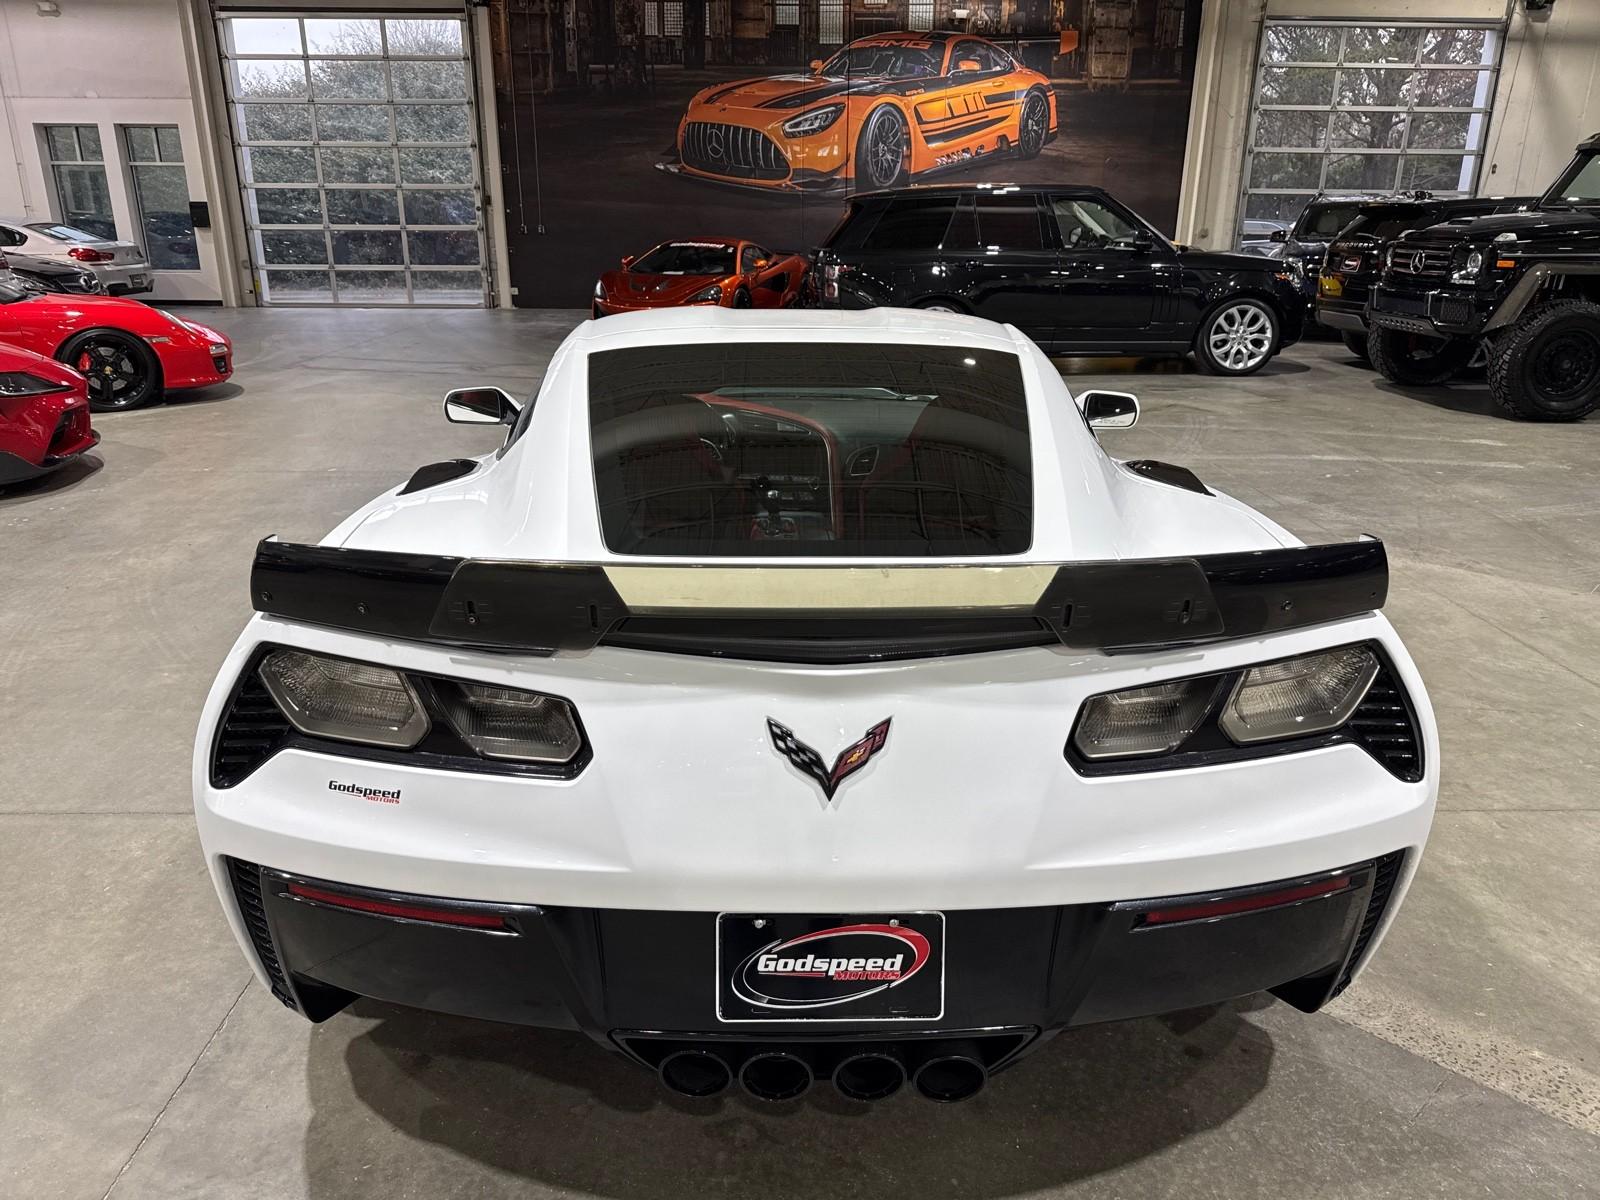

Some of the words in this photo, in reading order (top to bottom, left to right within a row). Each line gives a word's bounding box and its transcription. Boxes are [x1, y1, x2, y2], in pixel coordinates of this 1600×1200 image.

[868, 40, 933, 50] AMG
[328, 780, 401, 799] Godspeed
[366, 795, 400, 804] MOTORS
[757, 954, 904, 976] Godspeed
[833, 970, 901, 980] MOTORS
